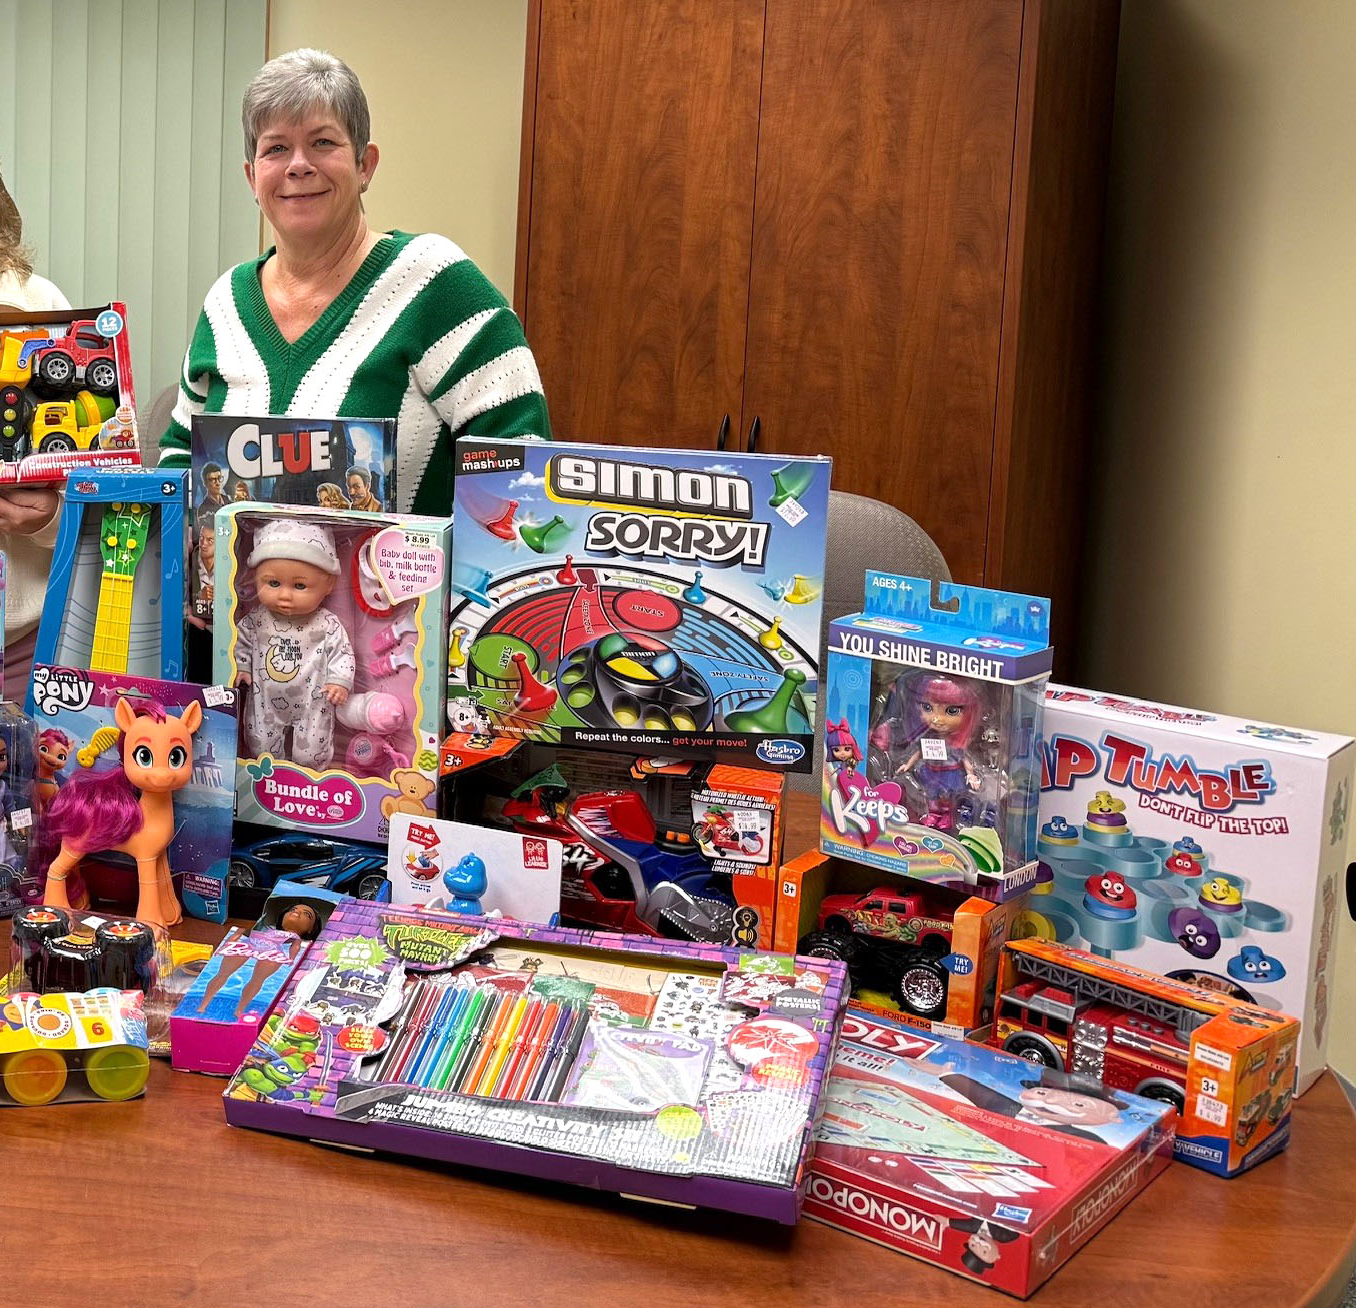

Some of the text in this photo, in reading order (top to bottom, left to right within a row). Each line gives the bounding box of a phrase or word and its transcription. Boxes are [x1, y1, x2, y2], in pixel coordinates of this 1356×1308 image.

[101, 317, 116, 327] 12
[227, 423, 331, 478] CLUE
[463, 449, 497, 462] game
[29, 457, 132, 469] Construction Vehicles
[163, 484, 175, 493] 3+
[218, 527, 230, 536] 3+
[591, 513, 768, 563] SORRY!
[404, 535, 430, 544] $ 8.99
[381, 549, 435, 562] Baby doll with
[395, 561, 437, 574] milk bottle
[389, 570, 427, 584] & feeding
[872, 576, 912, 591] AGES 4+
[401, 583, 413, 592] set
[196, 604, 206, 614] 8+
[630, 604, 664, 617] START
[840, 632, 1004, 678] YOU SHINE BRIGHT
[34, 681, 94, 715] PONY
[459, 712, 469, 721] 8+
[575, 731, 747, 748] Repeat the colors... get your move!
[757, 740, 802, 756] Hasbro
[444, 754, 462, 767] 3+
[767, 750, 795, 762] Gaming
[1104, 734, 1271, 811] TUMBLE
[264, 779, 353, 806] Bundle of
[863, 786, 880, 798] for
[273, 798, 326, 820] Love by
[831, 787, 908, 834] Keeps
[1140, 796, 1289, 834] DON'T THE TOP!
[1003, 863, 1039, 893] LONDON
[784, 884, 795, 894] 3+
[381, 914, 423, 926] TEENAGE
[219, 941, 292, 964] Barbie
[400, 941, 448, 956] MUTANT
[399, 949, 442, 963] MAYHEM
[954, 957, 969, 966] TRY
[954, 964, 968, 974] ME!
[882, 1009, 931, 1030] FORD F-150
[92, 1022, 104, 1035] 6
[857, 1060, 884, 1071] all!
[1203, 1080, 1216, 1092] 3+
[401, 1094, 483, 1117] JUMBO
[1184, 1142, 1221, 1158] VEHICLE
[1071, 1160, 1140, 1235] MONOPOLY
[805, 1175, 937, 1243] MONOPOL
